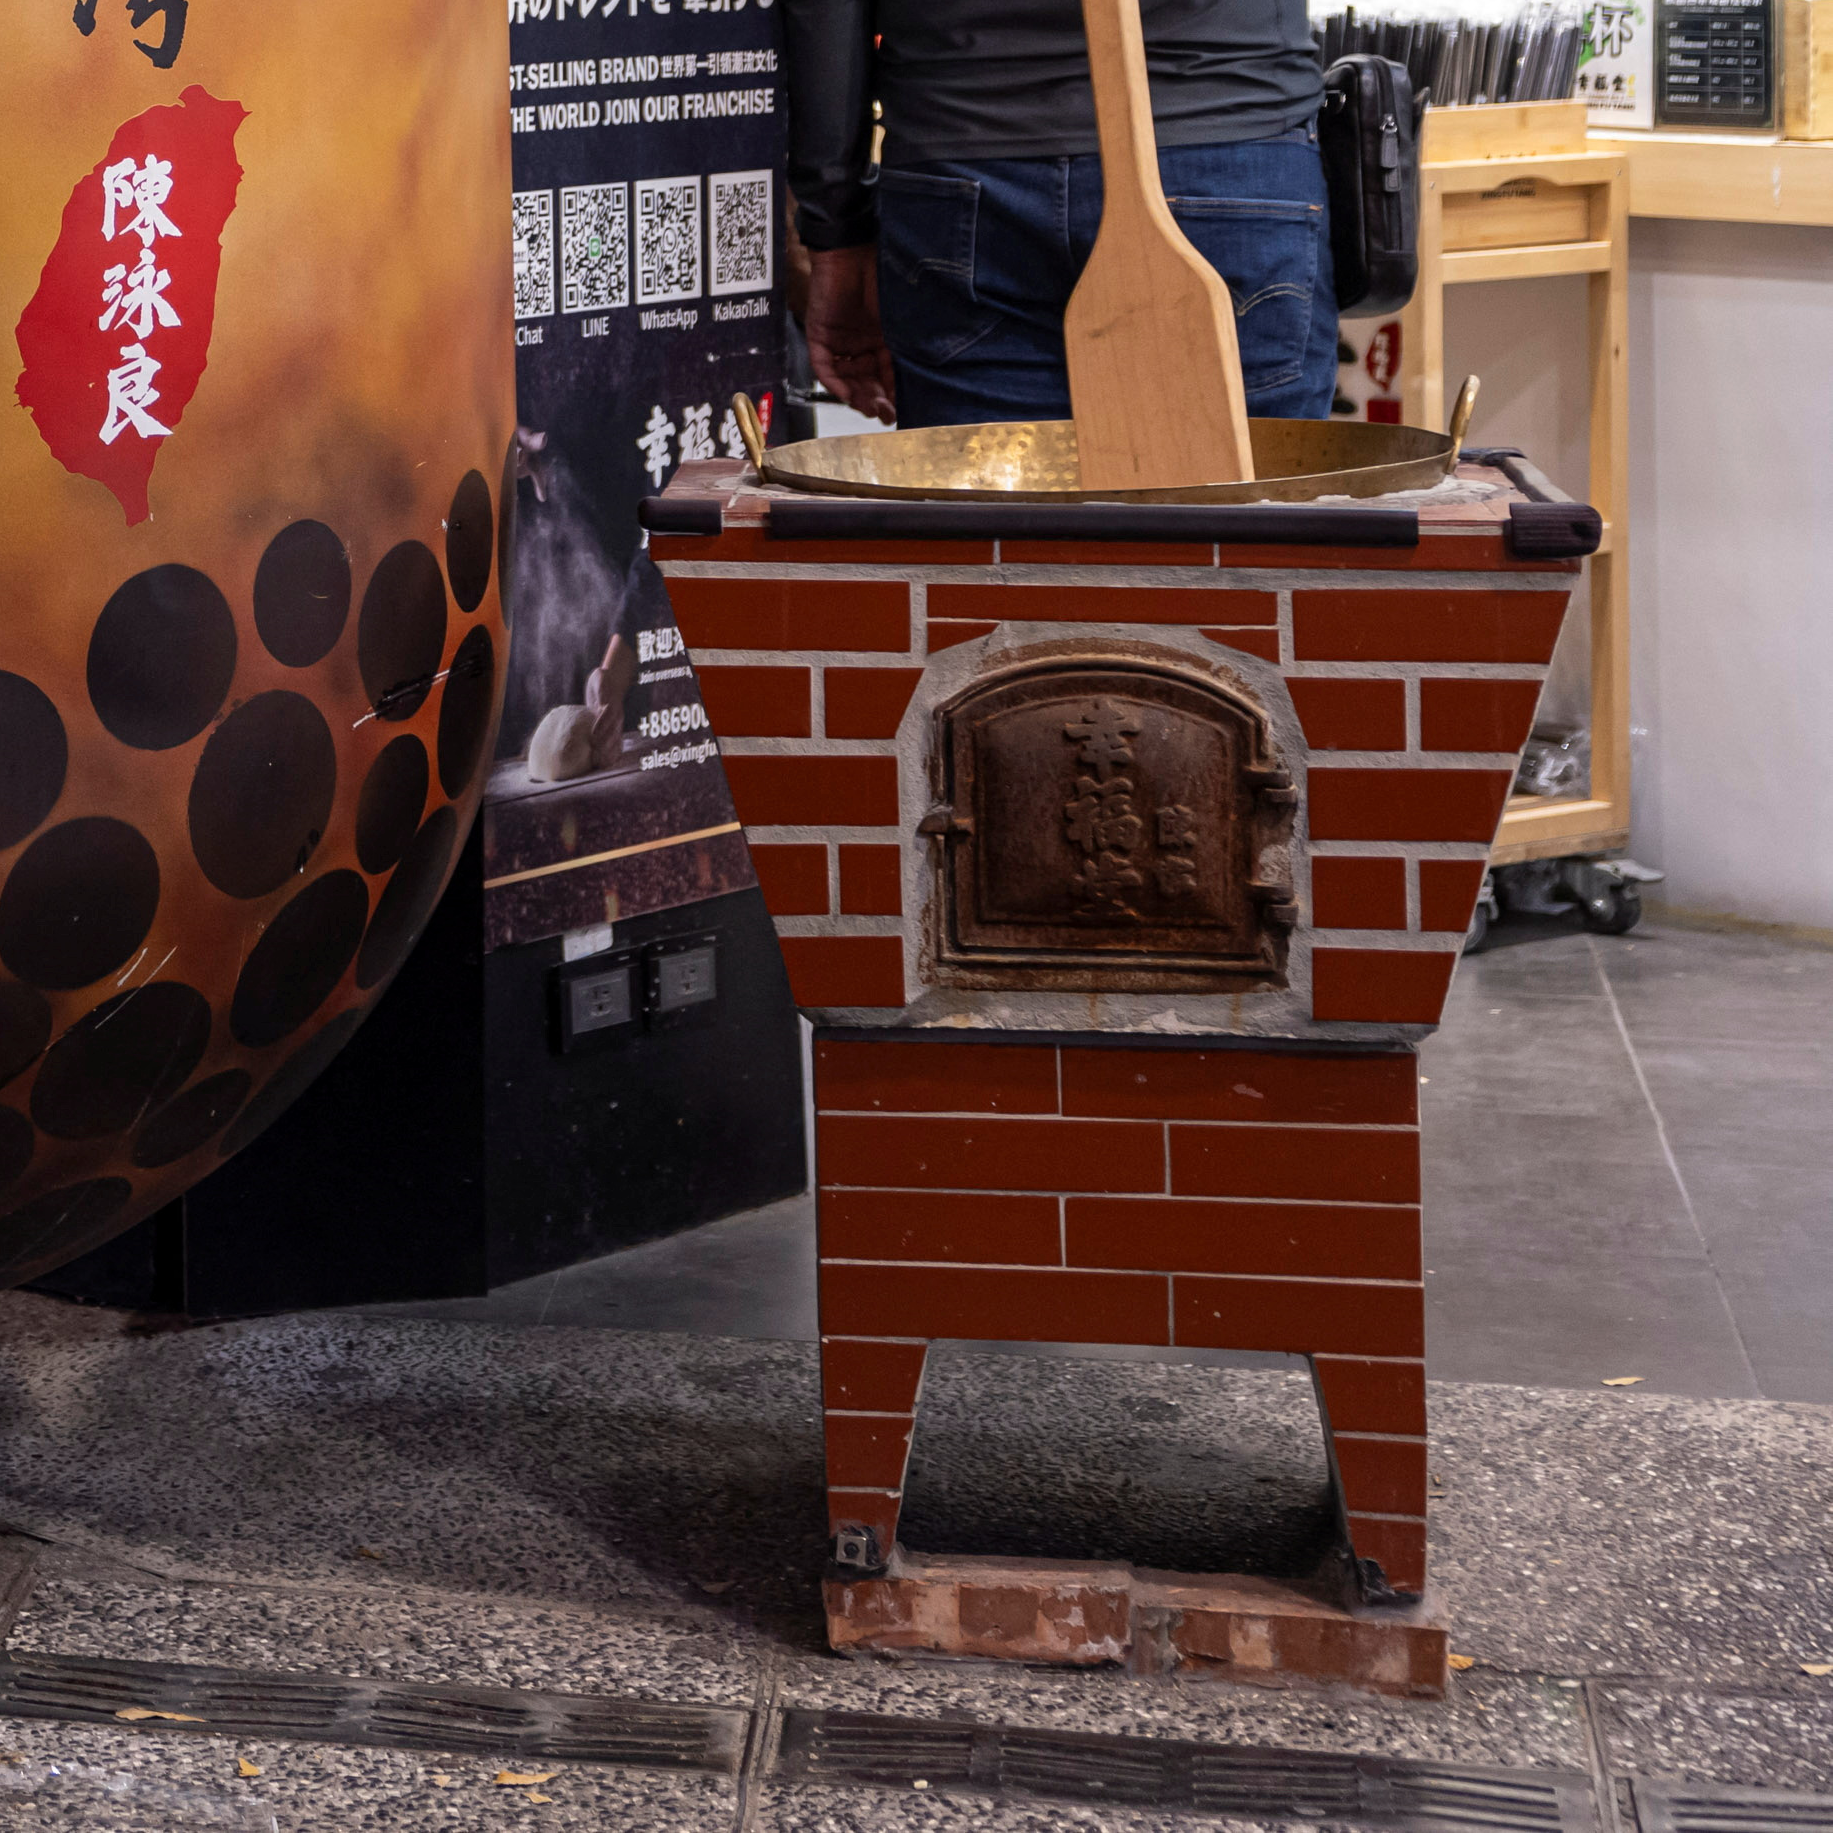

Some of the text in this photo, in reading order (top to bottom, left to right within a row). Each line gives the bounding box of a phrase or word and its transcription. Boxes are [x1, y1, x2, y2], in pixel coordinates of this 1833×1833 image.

[601, 55, 659, 85] BRAND
[661, 49, 778, 79] 世界第一引領潮流文化
[538, 101, 600, 131] WORLD
[602, 97, 640, 126] JOIN
[643, 94, 680, 123] OUR
[682, 88, 775, 120] FRANCHISE
[98, 153, 183, 445] 陳泳良
[713, 297, 770, 321] KakaoTalk
[582, 316, 610, 338] LINE
[639, 308, 698, 332] WhatsApp
[515, 325, 544, 346] Chat
